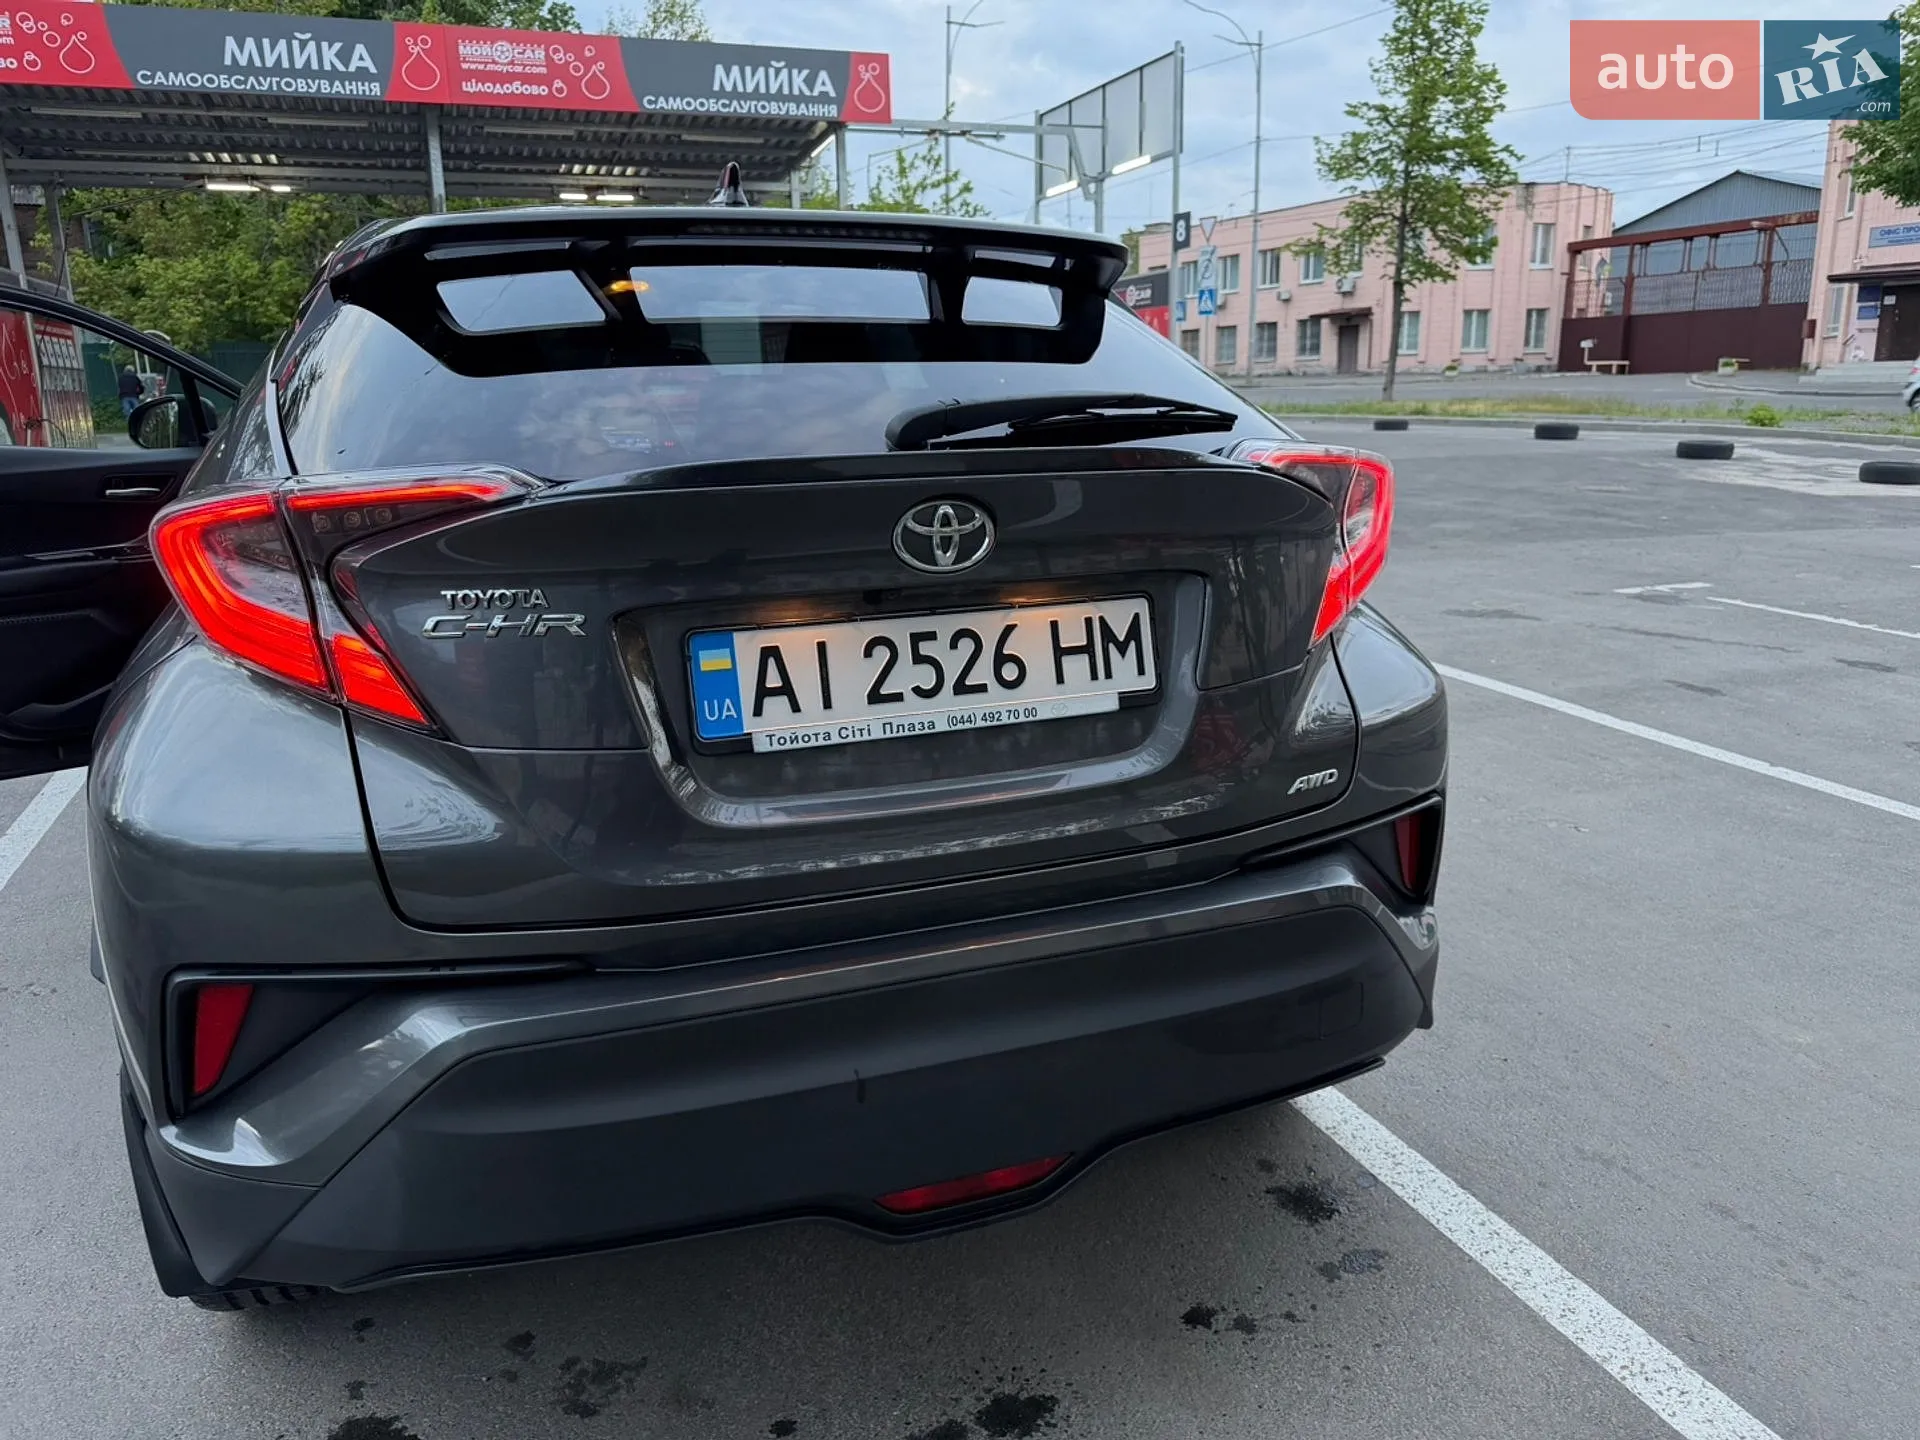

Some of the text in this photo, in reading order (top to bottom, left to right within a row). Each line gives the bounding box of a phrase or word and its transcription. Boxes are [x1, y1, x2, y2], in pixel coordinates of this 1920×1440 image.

[223, 33, 378, 74] МИЙКА
[136, 69, 381, 96] САМООБСЛУГОВУВАННЯ
[462, 78, 549, 95] цілодобово
[712, 60, 837, 98] МИЙКА
[642, 94, 838, 119] САМООБСЛУГОВУВАННЯ
[1176, 219, 1186, 242] 8
[440, 588, 550, 610] TOYOTA
[422, 613, 588, 639] C-HR
[752, 611, 1147, 718] AI 2526 HM
[704, 698, 738, 722] UA
[765, 706, 1038, 748] Тойота Сіті Плаза (044) 492 70 00
[1286, 768, 1339, 795] AWD
